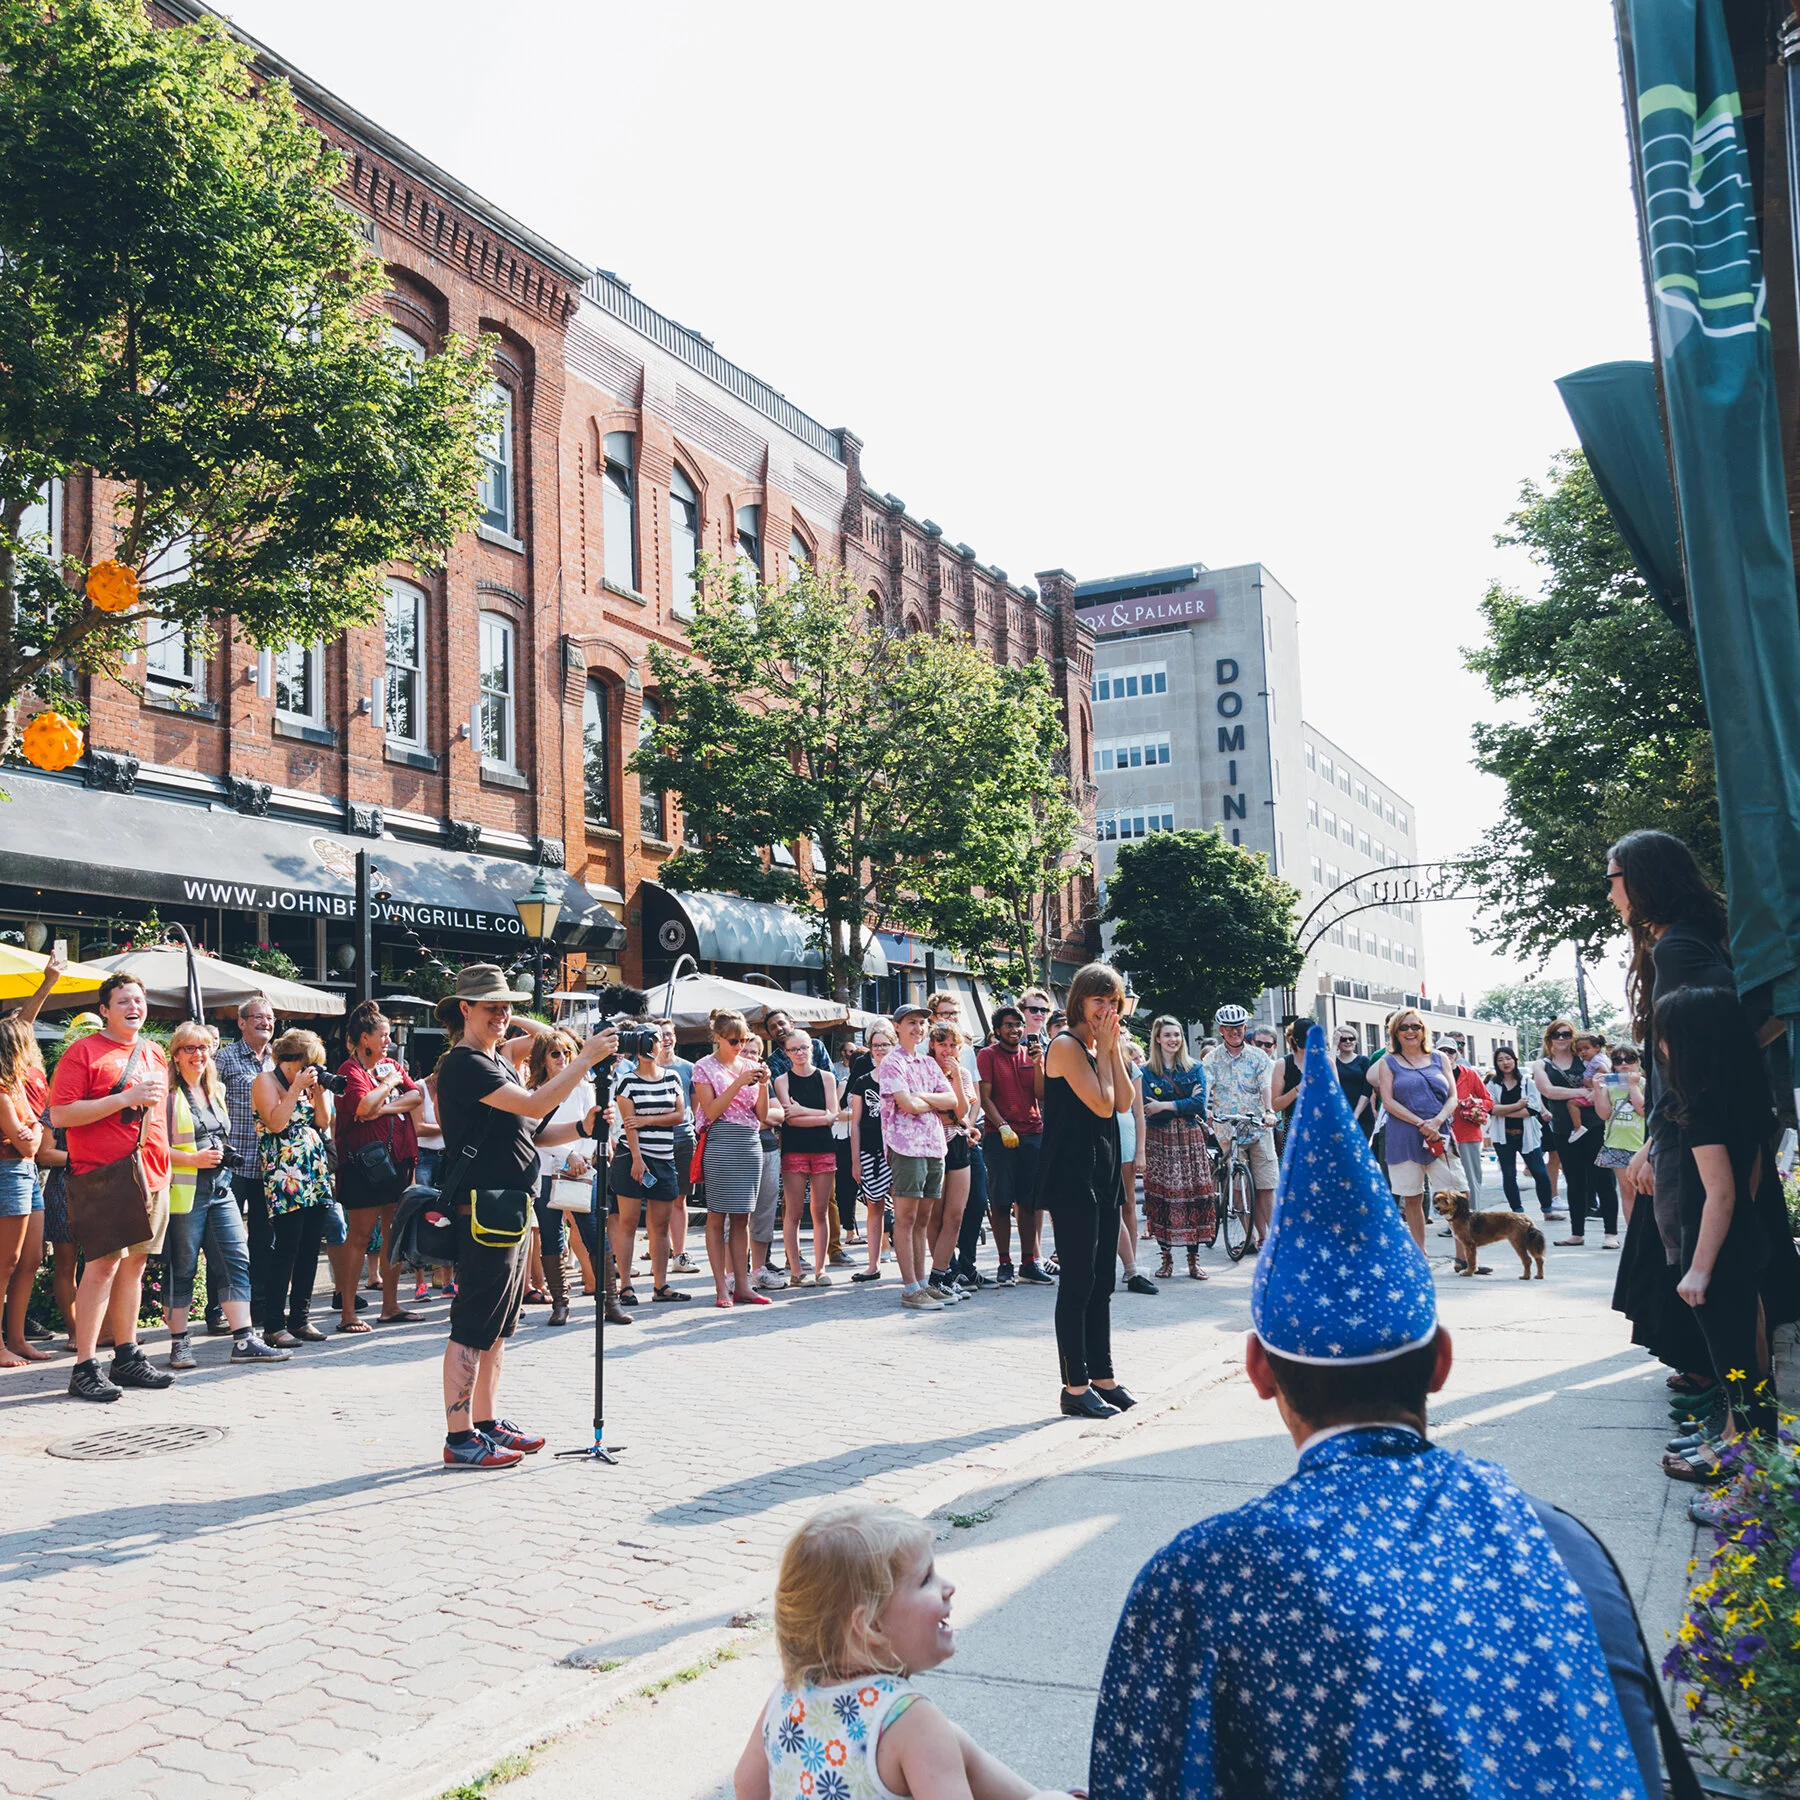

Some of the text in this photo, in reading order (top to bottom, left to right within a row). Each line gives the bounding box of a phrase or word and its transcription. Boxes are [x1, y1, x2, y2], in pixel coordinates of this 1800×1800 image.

[1111, 604, 1133, 627] &
[1135, 600, 1205, 621] PALMER
[1216, 658, 1246, 847] DOMINI
[183, 880, 526, 936] WWW.JOHNBOWNGRILLE.CO
